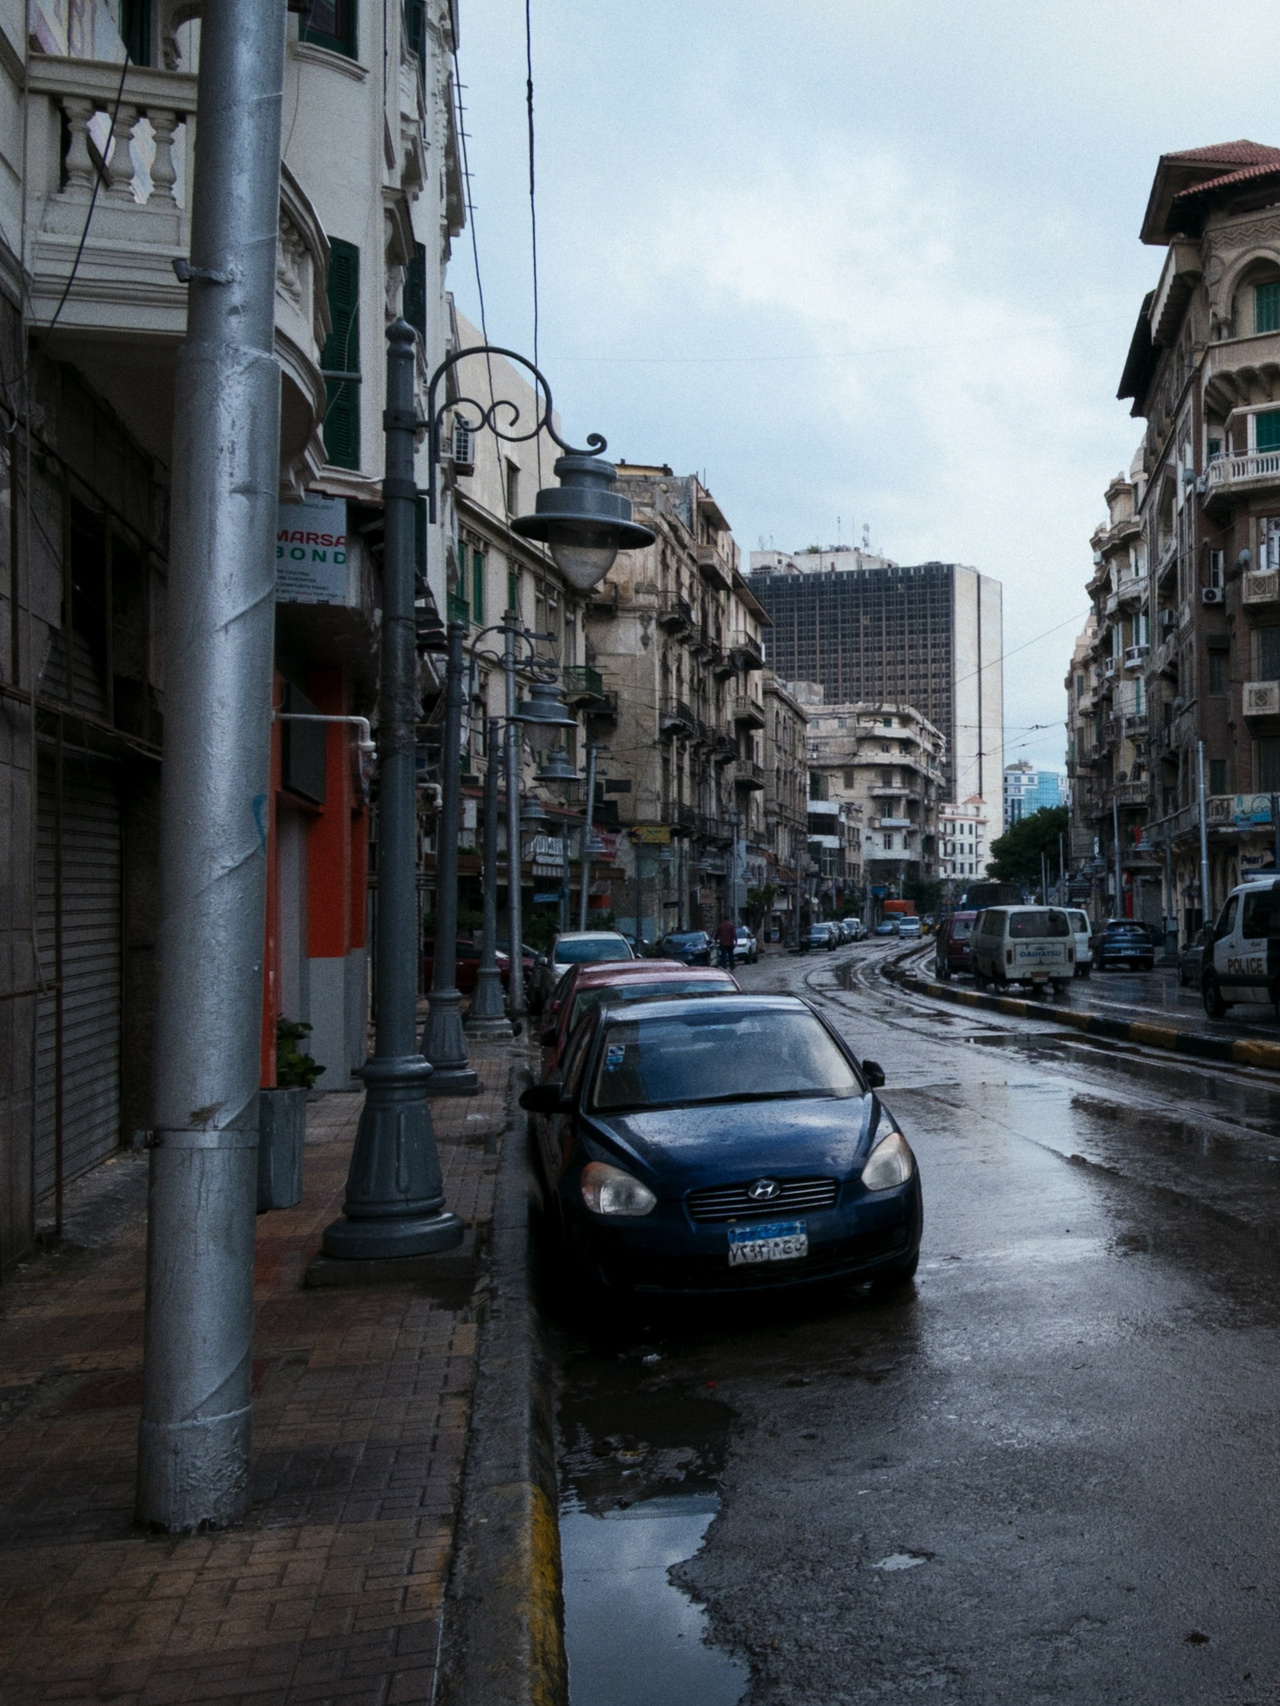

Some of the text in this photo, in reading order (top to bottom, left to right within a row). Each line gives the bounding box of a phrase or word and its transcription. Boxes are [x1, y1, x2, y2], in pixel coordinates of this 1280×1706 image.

[1241, 853, 1264, 865] Pearl
[1020, 950, 1061, 958] DAIHATSU
[1227, 958, 1263, 974] POLICE
